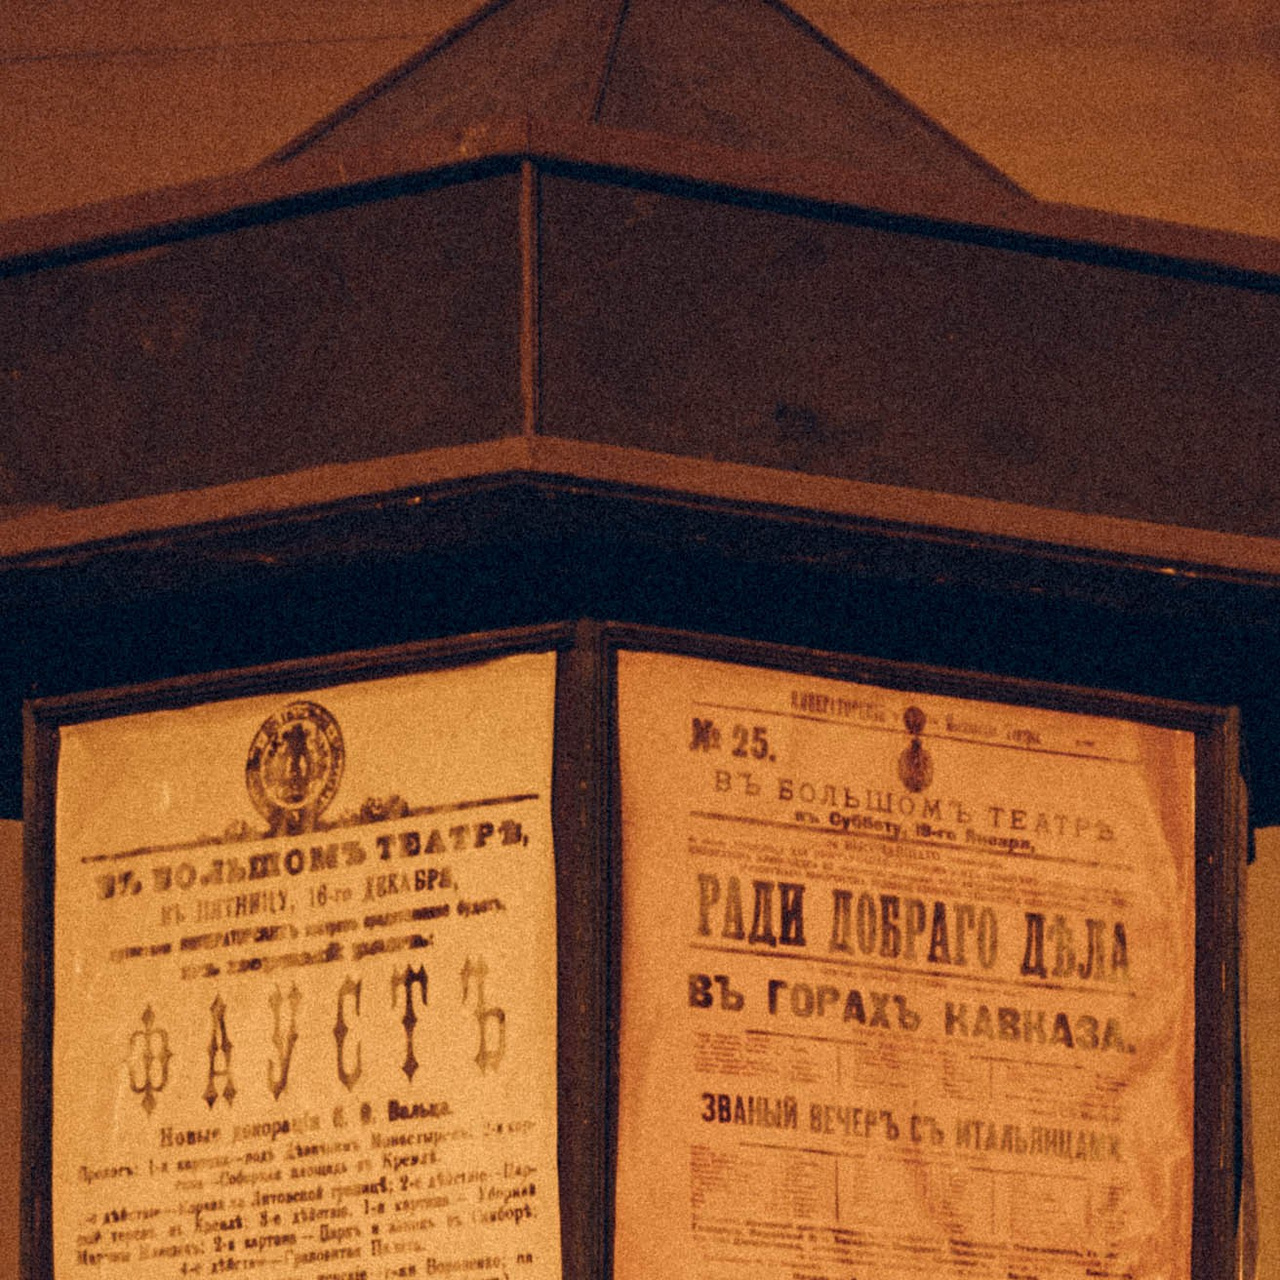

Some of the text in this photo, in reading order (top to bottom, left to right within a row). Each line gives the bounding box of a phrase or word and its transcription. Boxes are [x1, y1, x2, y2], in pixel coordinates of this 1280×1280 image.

[716, 770, 761, 796] ВЪ
[779, 778, 972, 825] БОЛЬШОМЪ
[697, 872, 807, 948] РАДИ
[831, 887, 999, 965] ДОБРАГО
[1020, 911, 1129, 983] ДѢЛА
[128, 956, 506, 1115] ФАУСТЪ
[688, 974, 1137, 1054] ВЪ ГОРАХЪ КАВКАЗА.
[701, 1092, 799, 1129] ЗВАНЫЙ
[809, 1104, 900, 1142] ВЕЧЕРЪ
